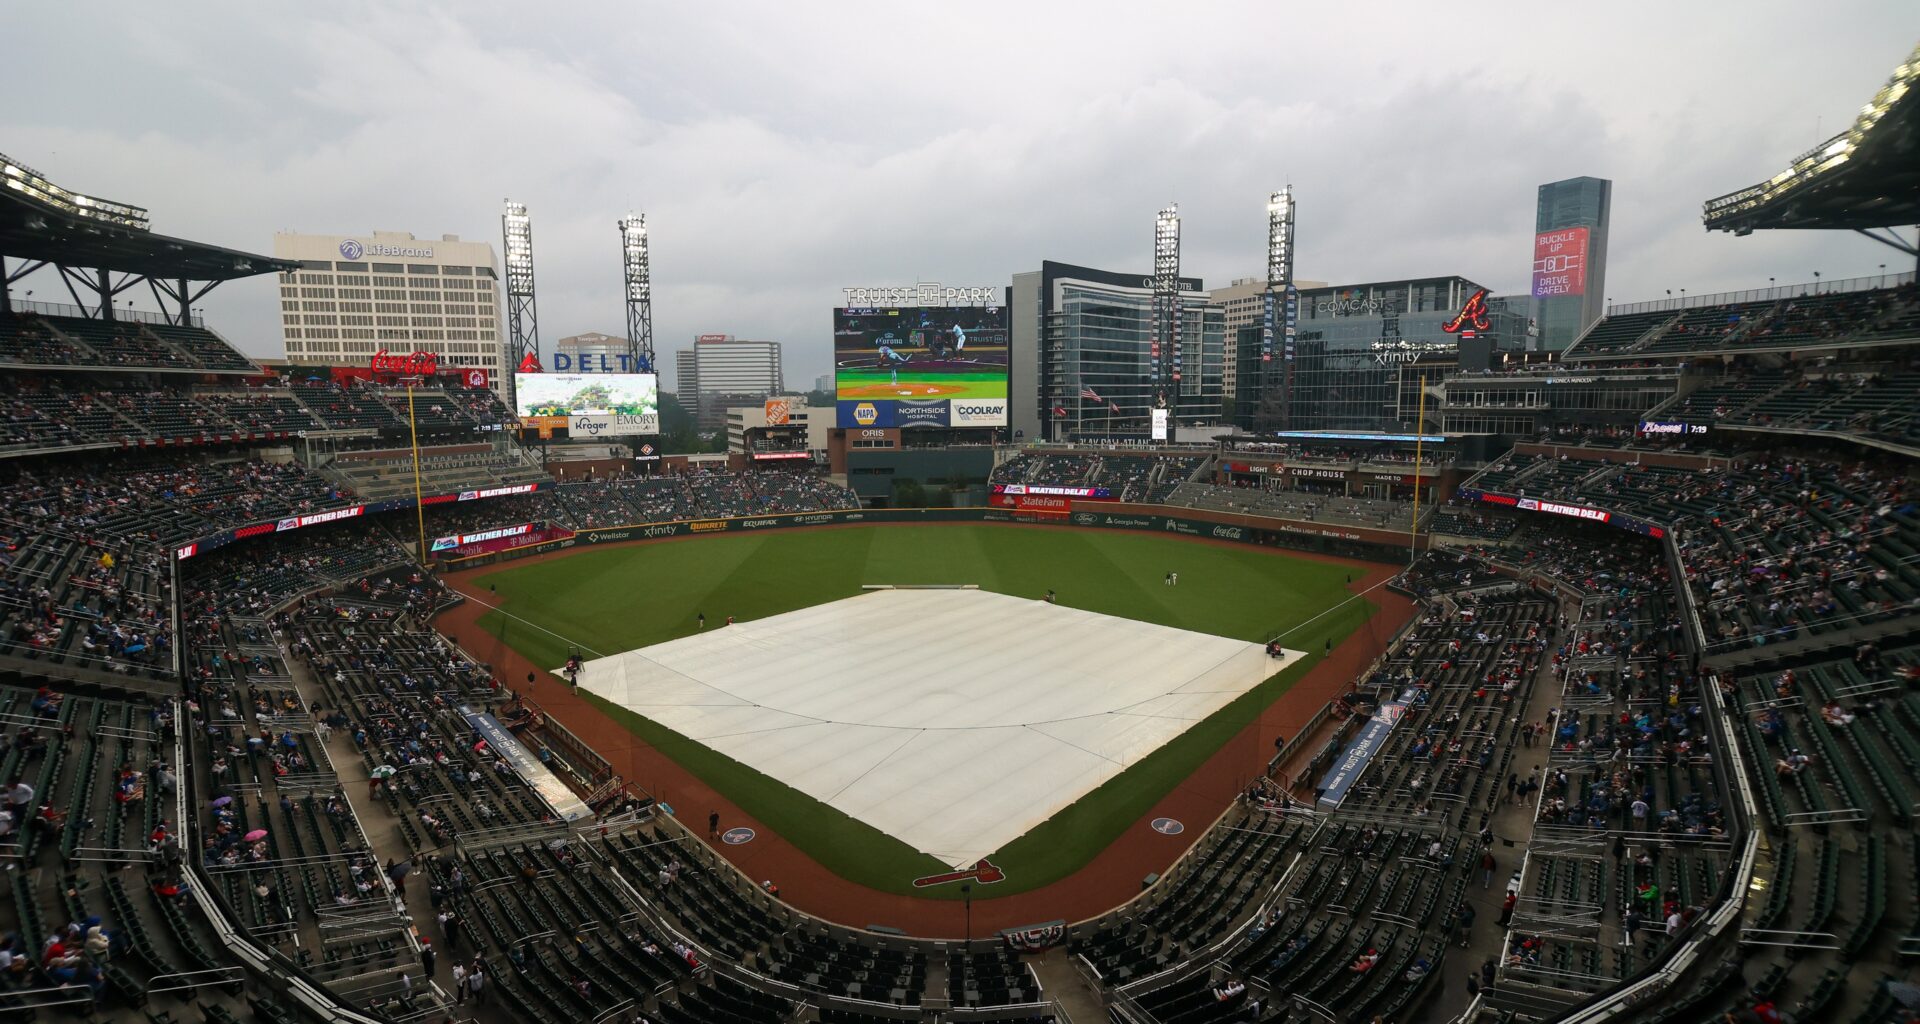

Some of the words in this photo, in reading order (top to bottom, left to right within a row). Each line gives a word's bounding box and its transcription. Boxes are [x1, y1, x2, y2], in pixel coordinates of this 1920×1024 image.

[1540, 232, 1575, 245] BUCKLE
[365, 244, 433, 258] LifeBrand
[1551, 243, 1562, 252] UP
[1540, 275, 1569, 286] DRIVE
[843, 287, 912, 303] TRUIST
[946, 287, 996, 302] PARK
[1537, 284, 1570, 295] SAFELY
[1317, 297, 1386, 312] COMCAST
[554, 353, 651, 372] DELTA
[1375, 350, 1421, 365] xfinity
[857, 409, 874, 418] NAPA
[958, 406, 1003, 414] COOLRAY
[575, 417, 608, 434] Kroger
[617, 415, 656, 425] EMORY
[1691, 425, 1707, 433] 7:19
[1317, 470, 1344, 478] HOUSE
[480, 486, 512, 498] WEATHER
[512, 485, 532, 493] DELAY
[1028, 487, 1064, 495] WEATHER
[1065, 488, 1090, 496] DELAY
[1541, 503, 1580, 516] WEATHER
[302, 512, 336, 525] WEATHER
[336, 508, 359, 519] DELAY
[690, 521, 728, 530] QUIKRETE
[743, 519, 777, 527] EQUIFAX
[463, 530, 501, 544] WEATHER
[502, 525, 528, 537] DELAY
[600, 532, 629, 540] Wellstar
[645, 525, 677, 538] xfinity
